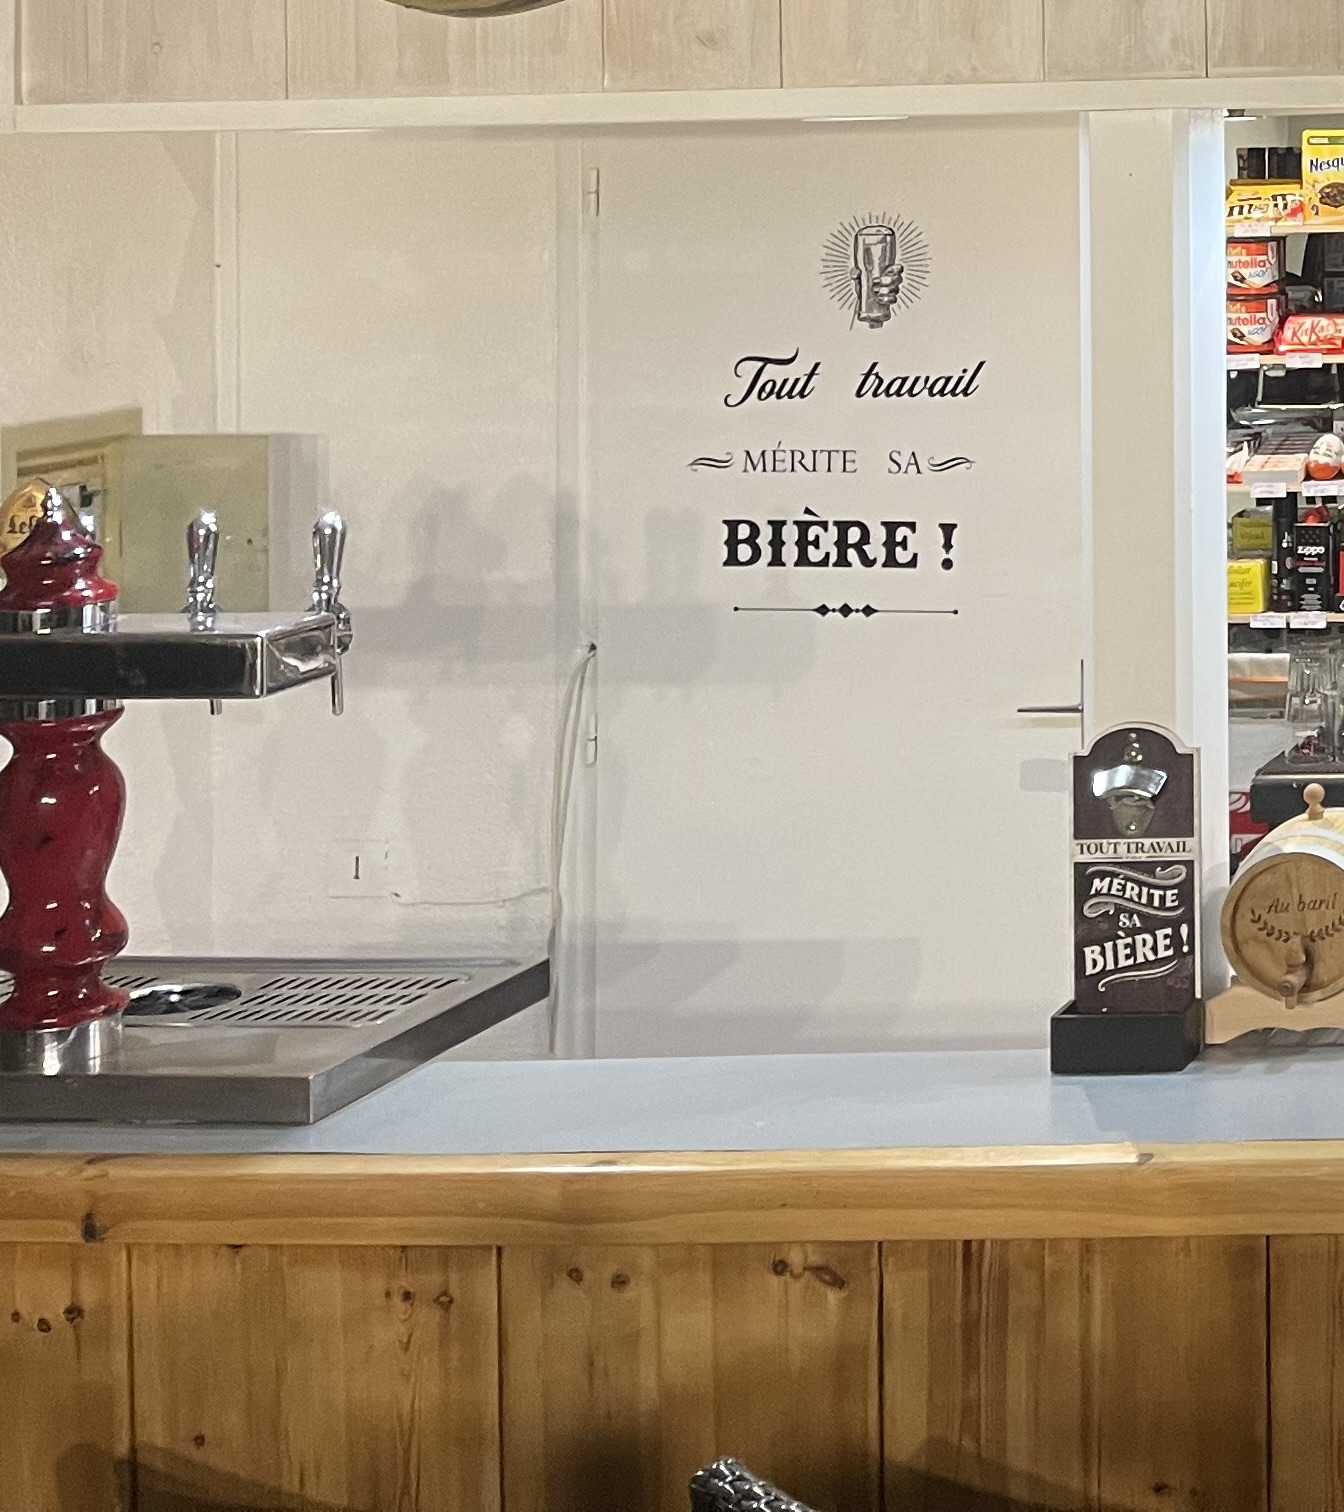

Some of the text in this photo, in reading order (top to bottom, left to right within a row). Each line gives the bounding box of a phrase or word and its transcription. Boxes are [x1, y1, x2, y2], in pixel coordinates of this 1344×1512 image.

[723, 347, 987, 407] Tout travail
[742, 440, 923, 474] MÉRITE SA
[7, 514, 41, 534] Lef
[721, 506, 918, 569] BIÈRE
[1075, 839, 1192, 856] TOUT TRAVAIL
[1088, 873, 1179, 909] MÉRITE
[1266, 892, 1338, 914] Au baril
[1117, 912, 1142, 929] SA
[1082, 926, 1174, 976] BIÈRE
